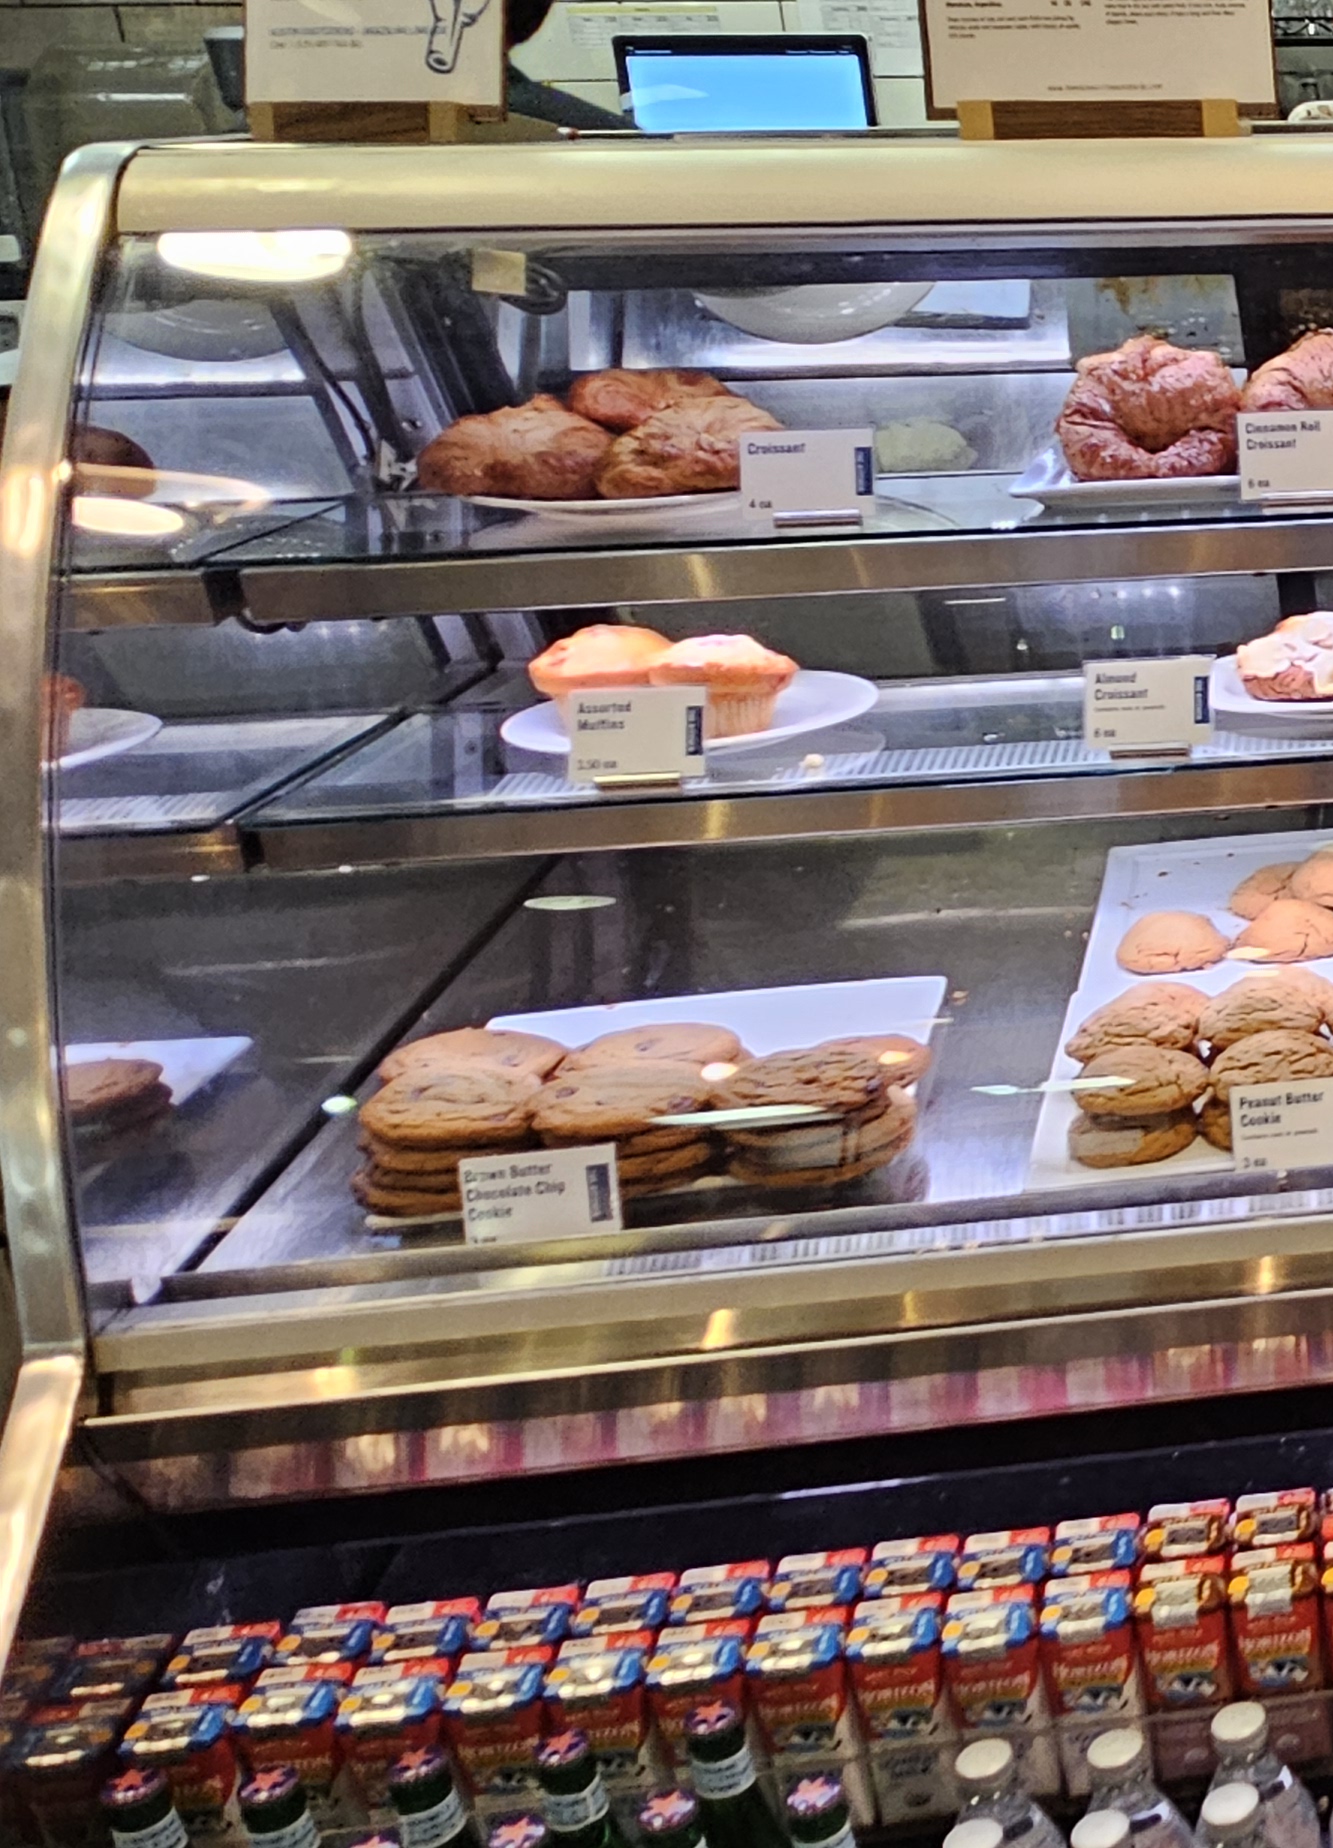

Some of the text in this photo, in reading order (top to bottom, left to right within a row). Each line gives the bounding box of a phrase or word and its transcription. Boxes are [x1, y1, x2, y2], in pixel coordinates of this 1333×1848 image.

[1245, 420, 1321, 434] Cinnamon Roll
[747, 442, 806, 455] Croissant
[1246, 439, 1297, 450] Croissant
[1257, 479, 1270, 487] ea
[749, 499, 773, 509] 4 ea
[1094, 672, 1137, 684] Almond
[1094, 689, 1148, 701] Croissant
[577, 702, 632, 714] Assorted
[577, 719, 625, 731] Muffins
[1239, 1092, 1324, 1109] Peanut Butter
[1240, 1112, 1281, 1127] Cookie
[1253, 1157, 1268, 1167] ea
[464, 1163, 553, 1184] Brown Butter
[466, 1180, 566, 1202] Chocolate Chip
[468, 1206, 512, 1221] Cookie
